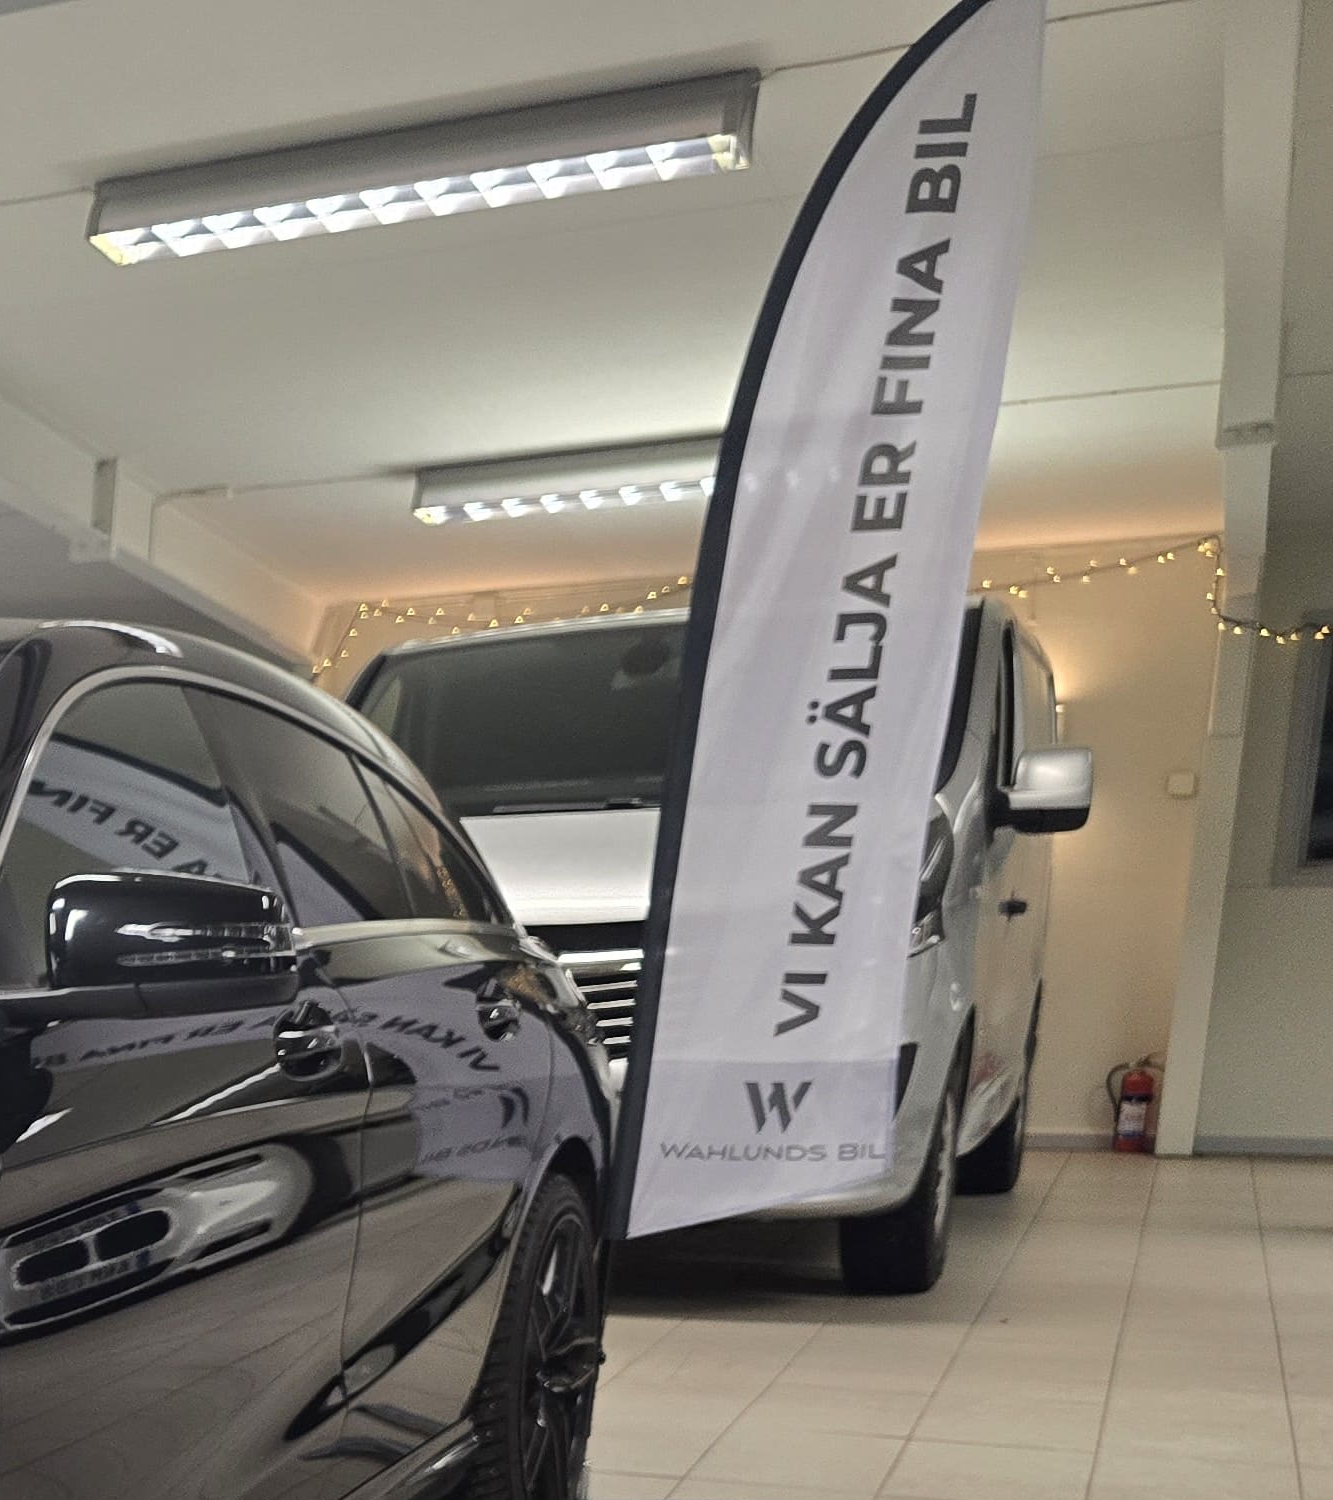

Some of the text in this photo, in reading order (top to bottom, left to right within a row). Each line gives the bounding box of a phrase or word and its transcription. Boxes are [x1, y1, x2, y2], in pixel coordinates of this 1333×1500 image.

[773, 92, 979, 1037] VI KAN SÄLJA ER FINA BIL
[659, 1140, 887, 1163] WAHLUNDS BIL
